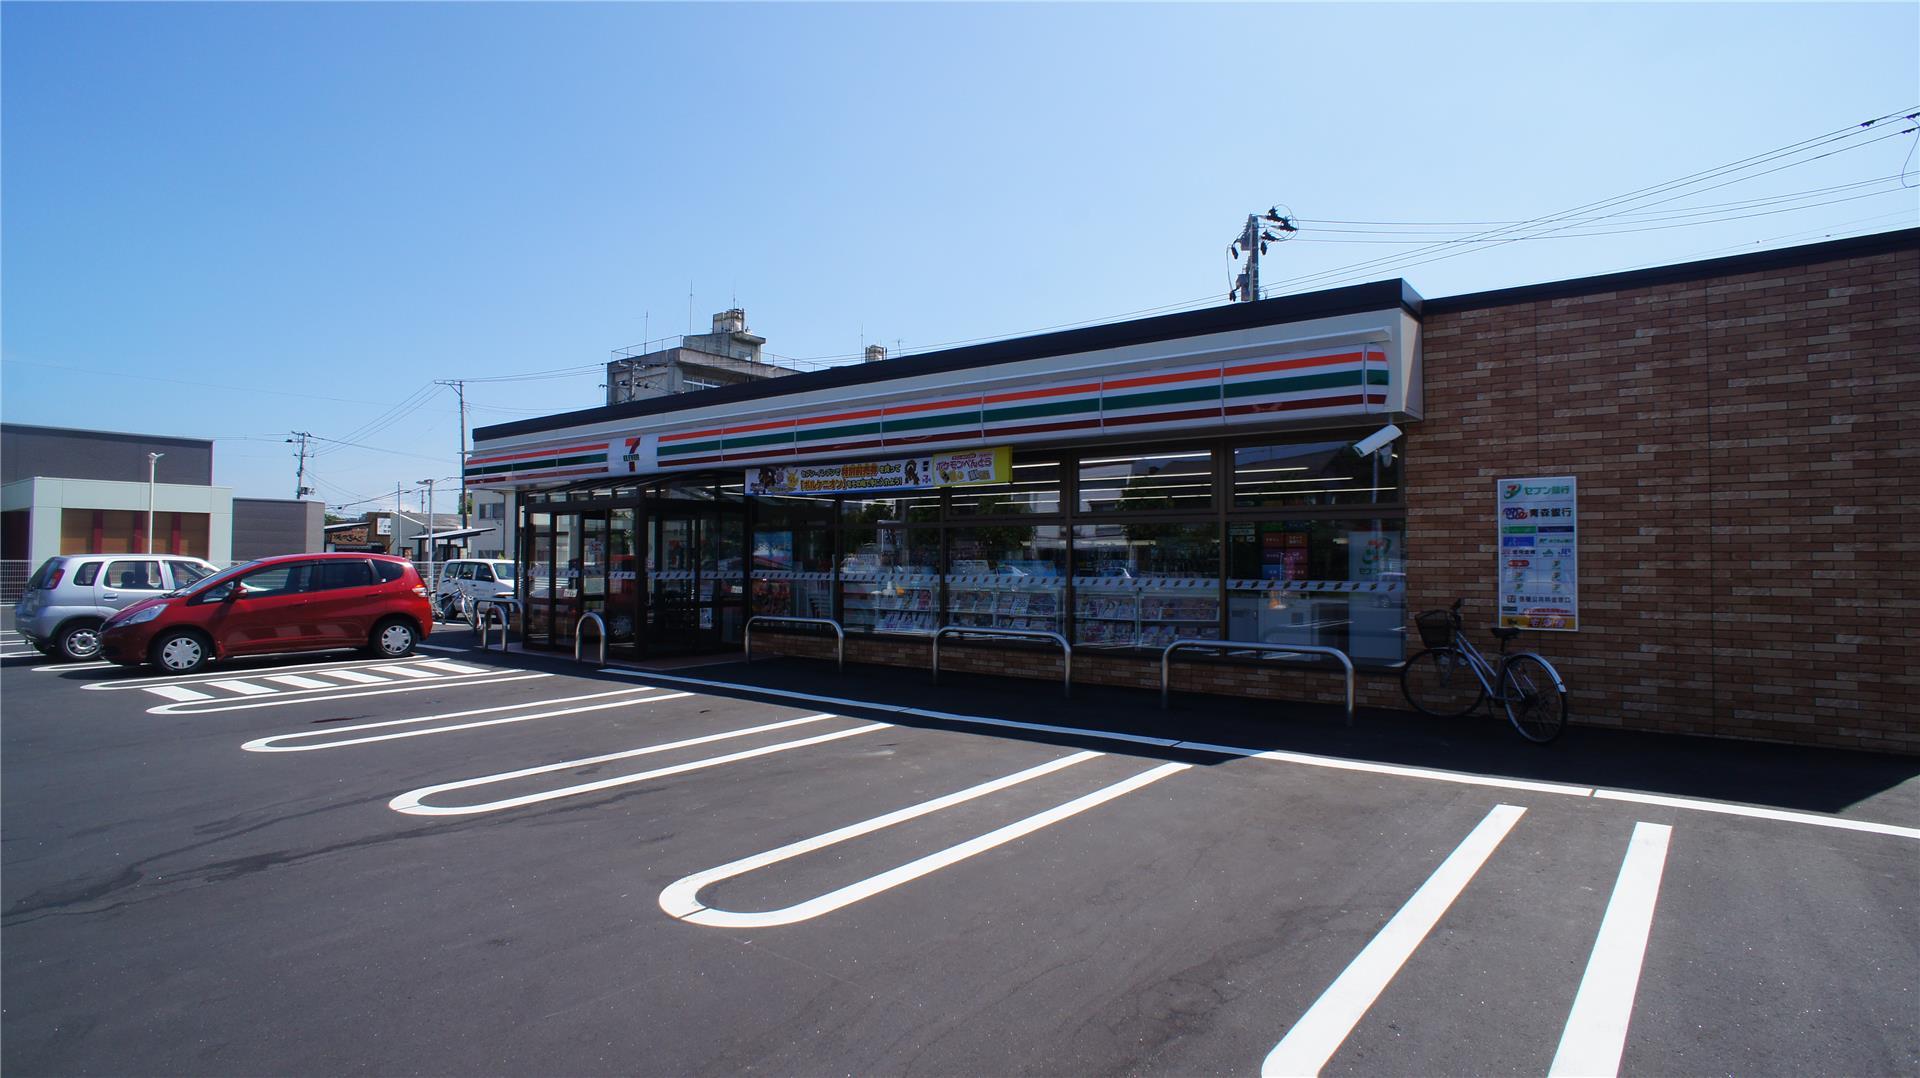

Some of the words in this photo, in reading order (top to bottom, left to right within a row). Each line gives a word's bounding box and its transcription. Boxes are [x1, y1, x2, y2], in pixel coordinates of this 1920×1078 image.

[625, 437, 640, 472] 7
[1525, 486, 1569, 496] セブン銀行
[1529, 507, 1571, 517] 青森銀行
